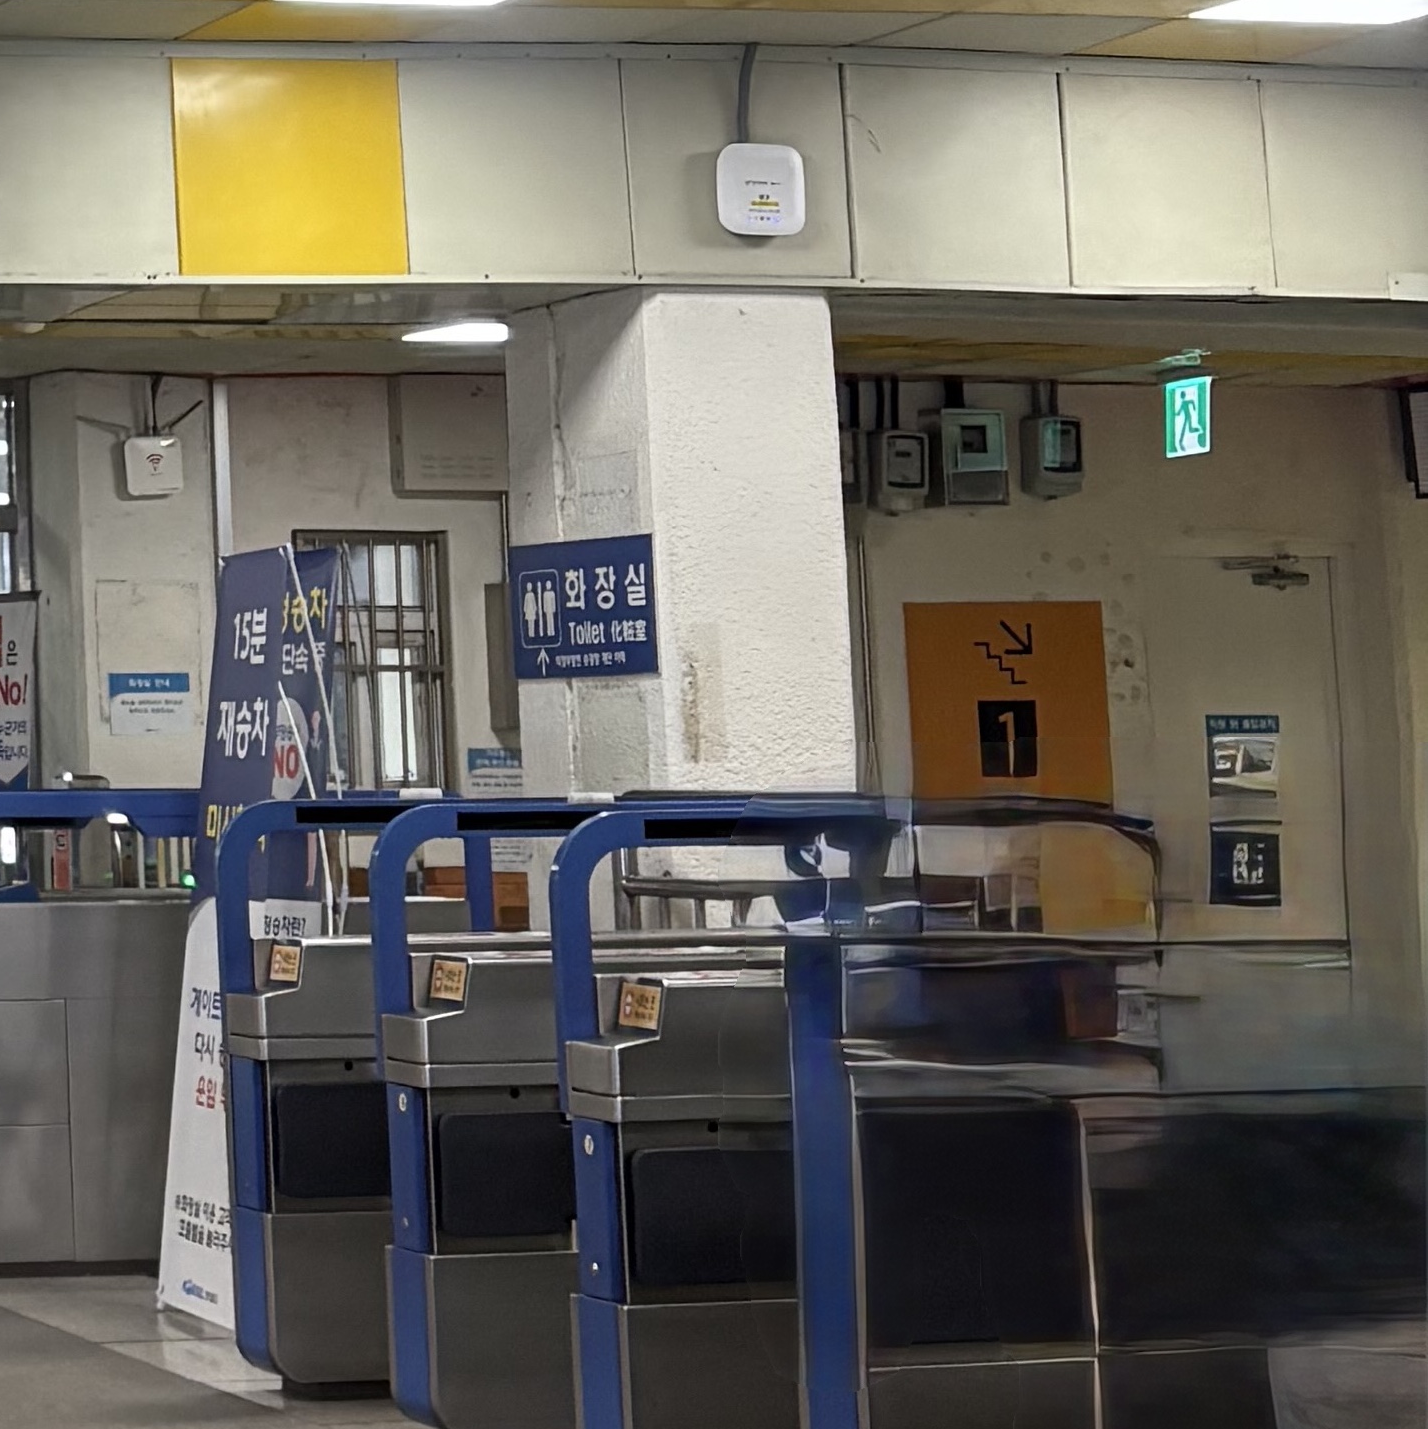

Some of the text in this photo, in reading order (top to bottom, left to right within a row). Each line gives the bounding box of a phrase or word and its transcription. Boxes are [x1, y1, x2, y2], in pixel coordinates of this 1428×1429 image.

[565, 563, 647, 610] 화장실
[233, 608, 267, 665] 15분
[568, 620, 606, 646] Toilet
[282, 642, 309, 675] 단속
[217, 697, 269, 760] 재승차
[999, 711, 1015, 777] 1
[274, 745, 299, 778] NO
[195, 1031, 215, 1065] 다시
